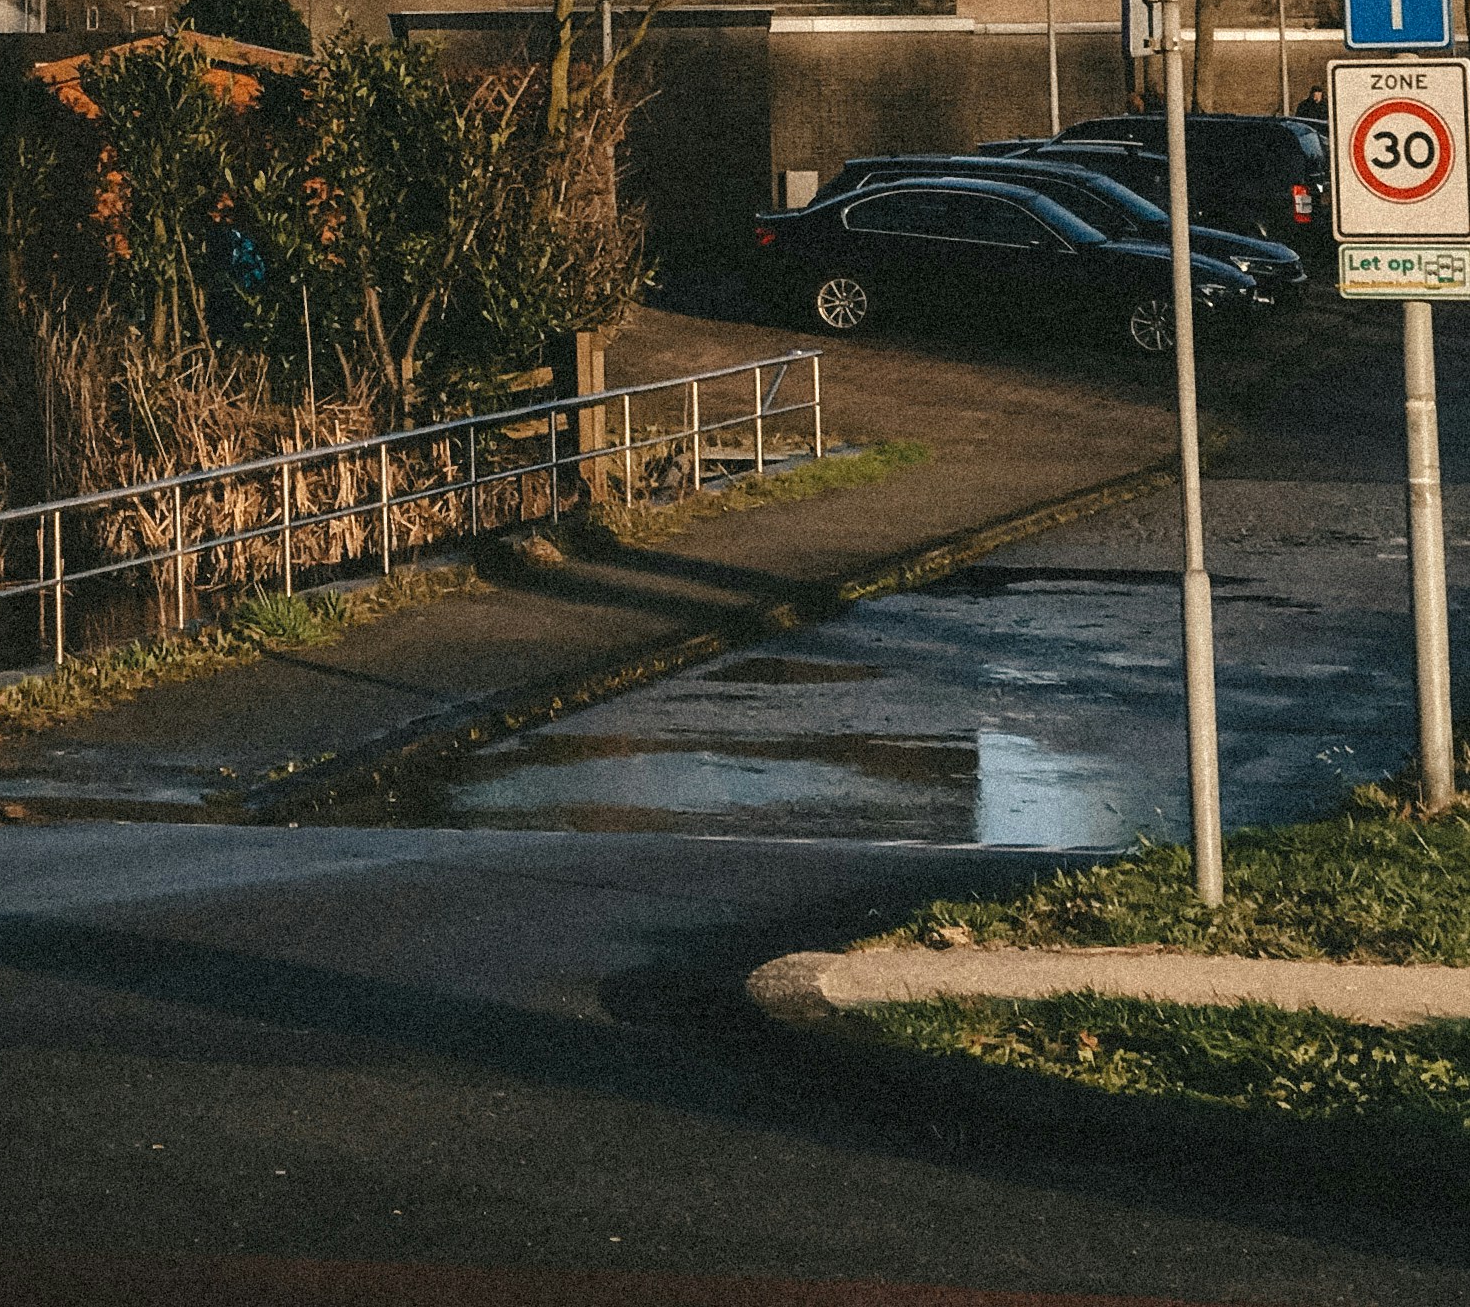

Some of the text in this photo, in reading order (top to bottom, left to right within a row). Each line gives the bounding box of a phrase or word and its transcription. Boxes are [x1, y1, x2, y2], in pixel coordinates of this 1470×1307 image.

[1370, 74, 1428, 90] ZONE
[1371, 131, 1435, 170] 30
[1348, 254, 1423, 276] Let op!
